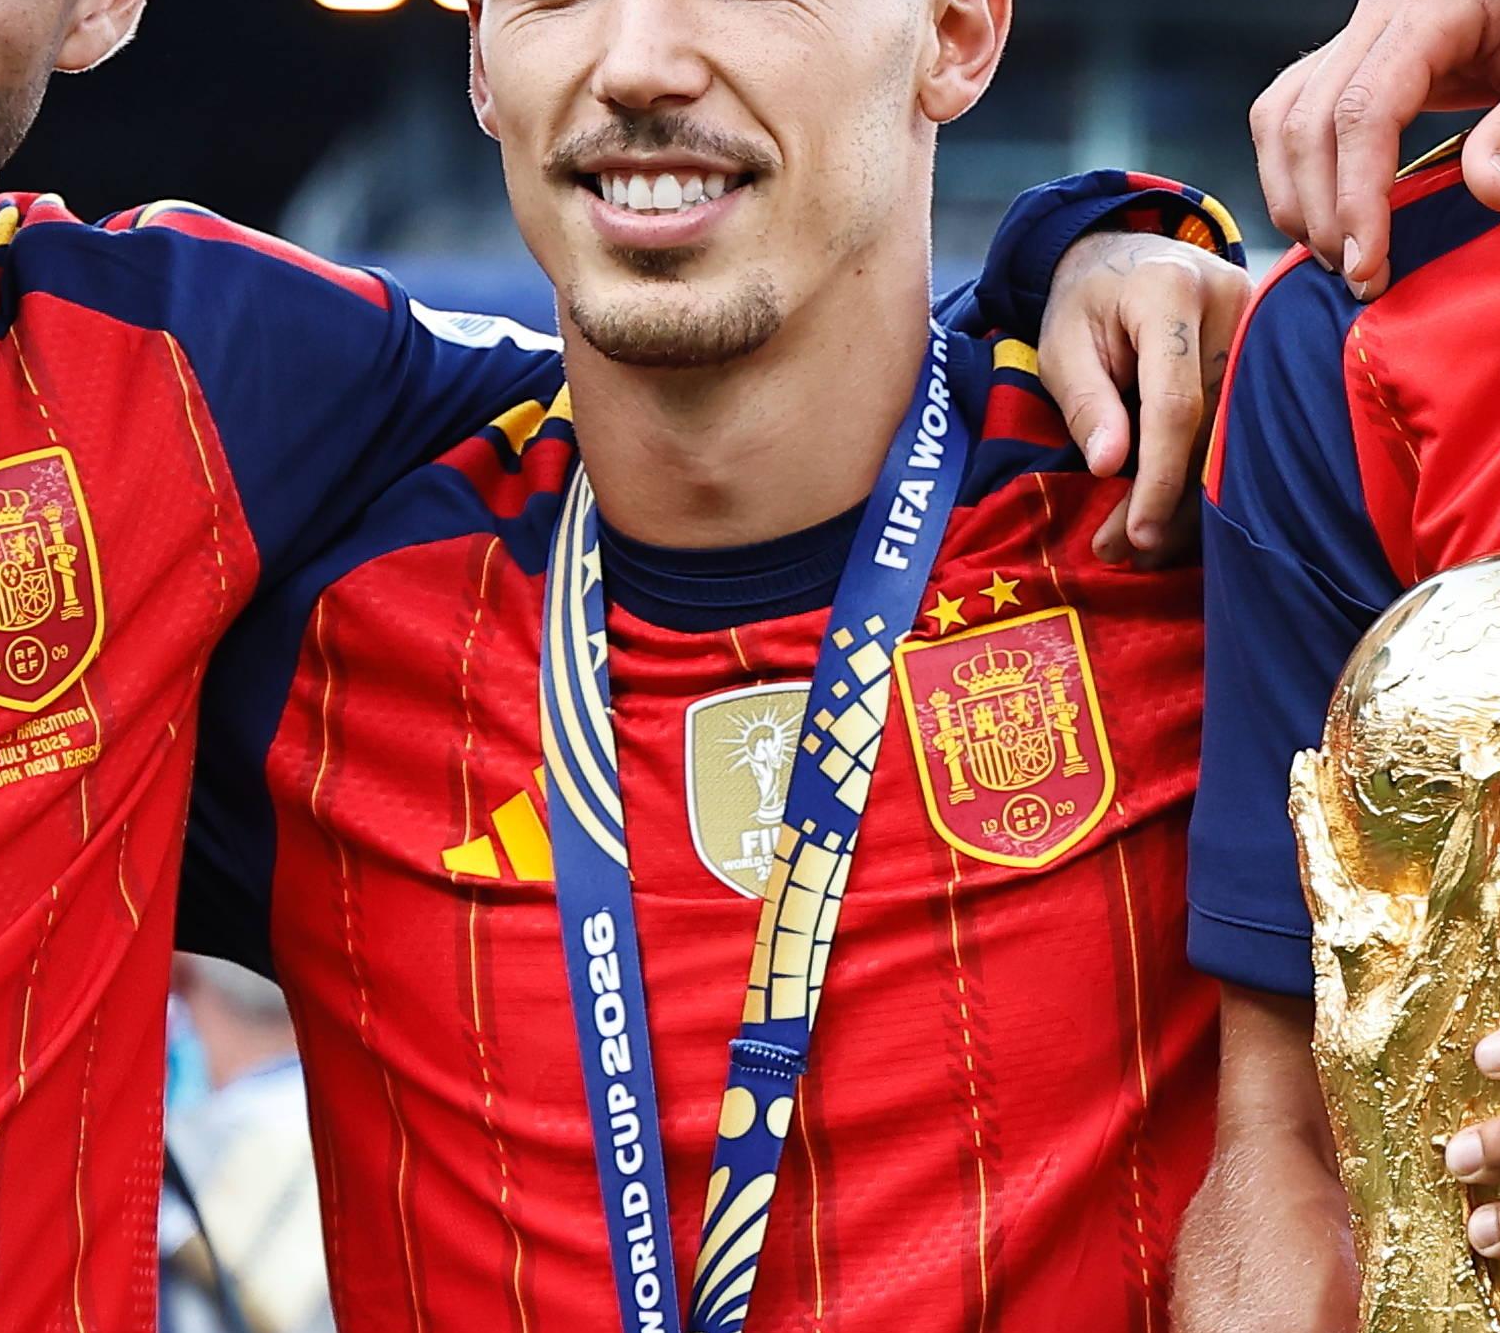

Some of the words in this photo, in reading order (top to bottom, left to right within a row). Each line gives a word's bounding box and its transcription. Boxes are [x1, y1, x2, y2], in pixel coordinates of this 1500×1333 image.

[874, 479, 935, 570] FIFA
[13, 648, 37, 661] RF
[51, 644, 69, 661] 09
[16, 659, 39, 673] EF
[30, 732, 71, 756] 2026
[1012, 804, 1037, 819] RF
[1054, 799, 1076, 816] 09
[981, 819, 999, 836] 19
[1015, 817, 1041, 831] EF
[583, 910, 632, 1074] 2026
[607, 1083, 645, 1173] CUP
